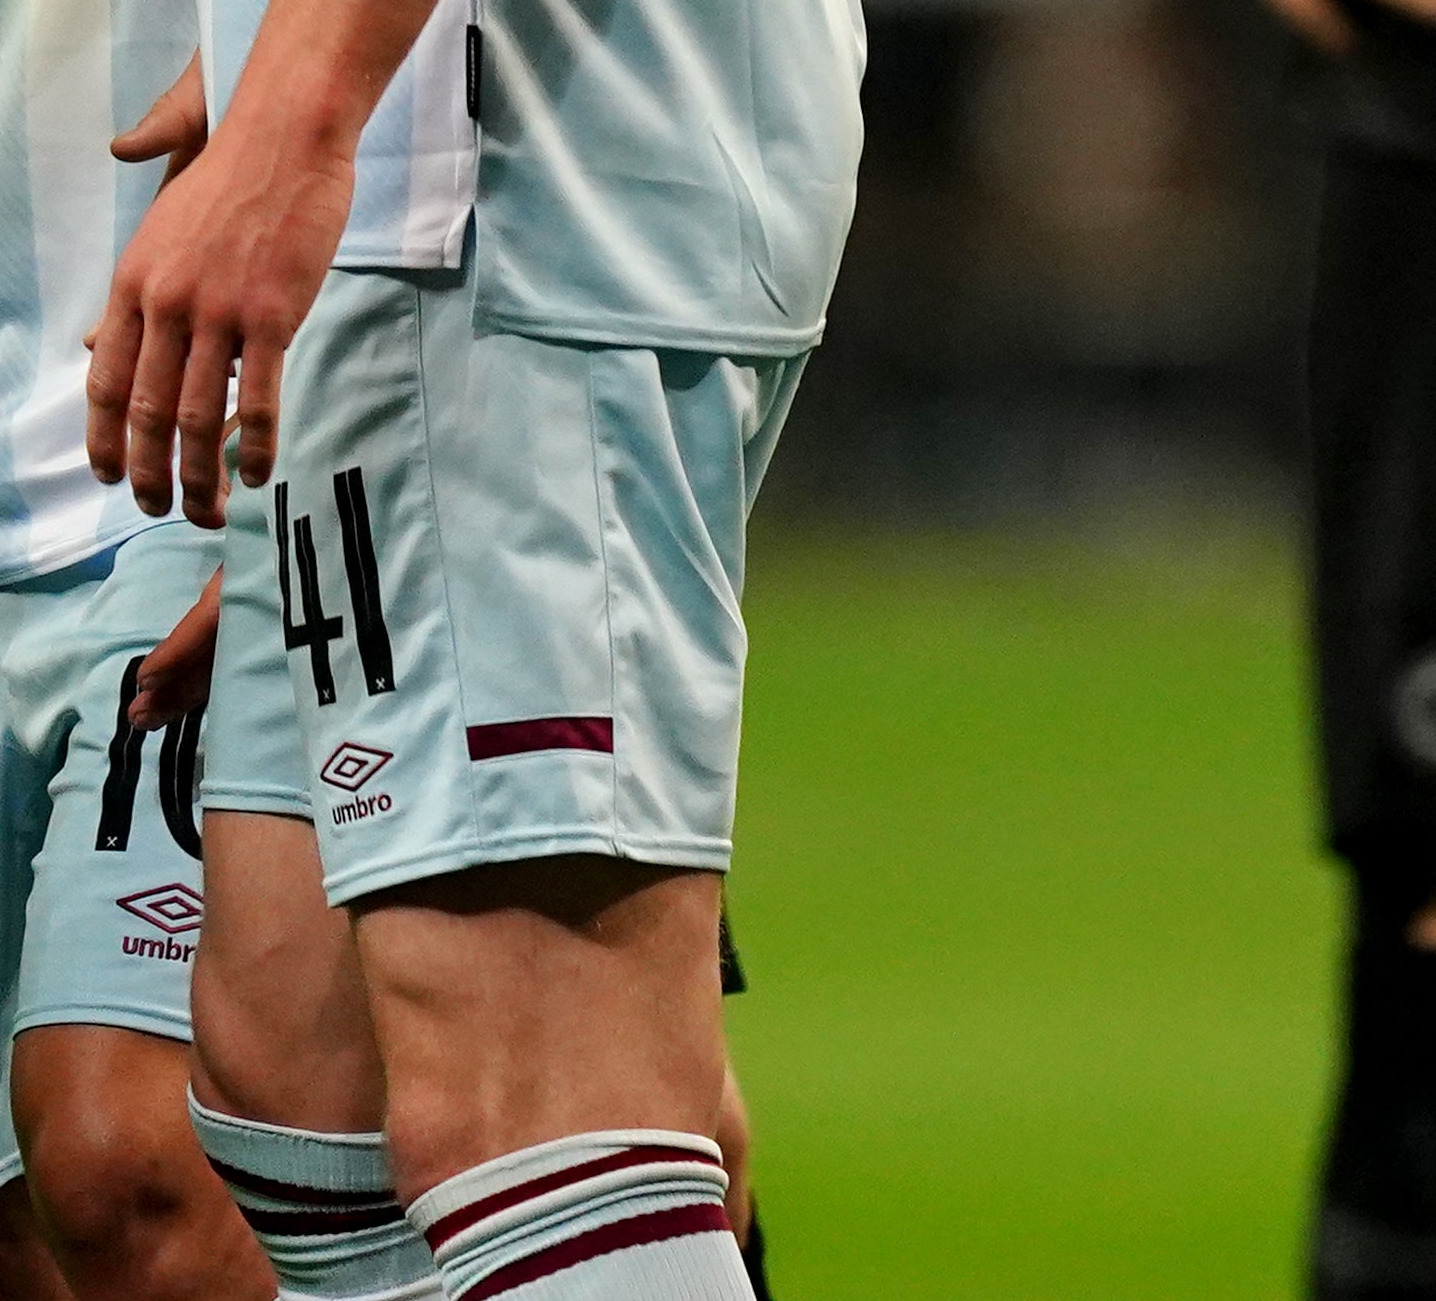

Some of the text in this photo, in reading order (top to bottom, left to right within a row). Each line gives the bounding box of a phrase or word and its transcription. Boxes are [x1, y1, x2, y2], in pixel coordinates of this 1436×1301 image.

[274, 465, 397, 708] 41
[331, 793, 393, 826] umbro
[122, 936, 197, 963] umbr
